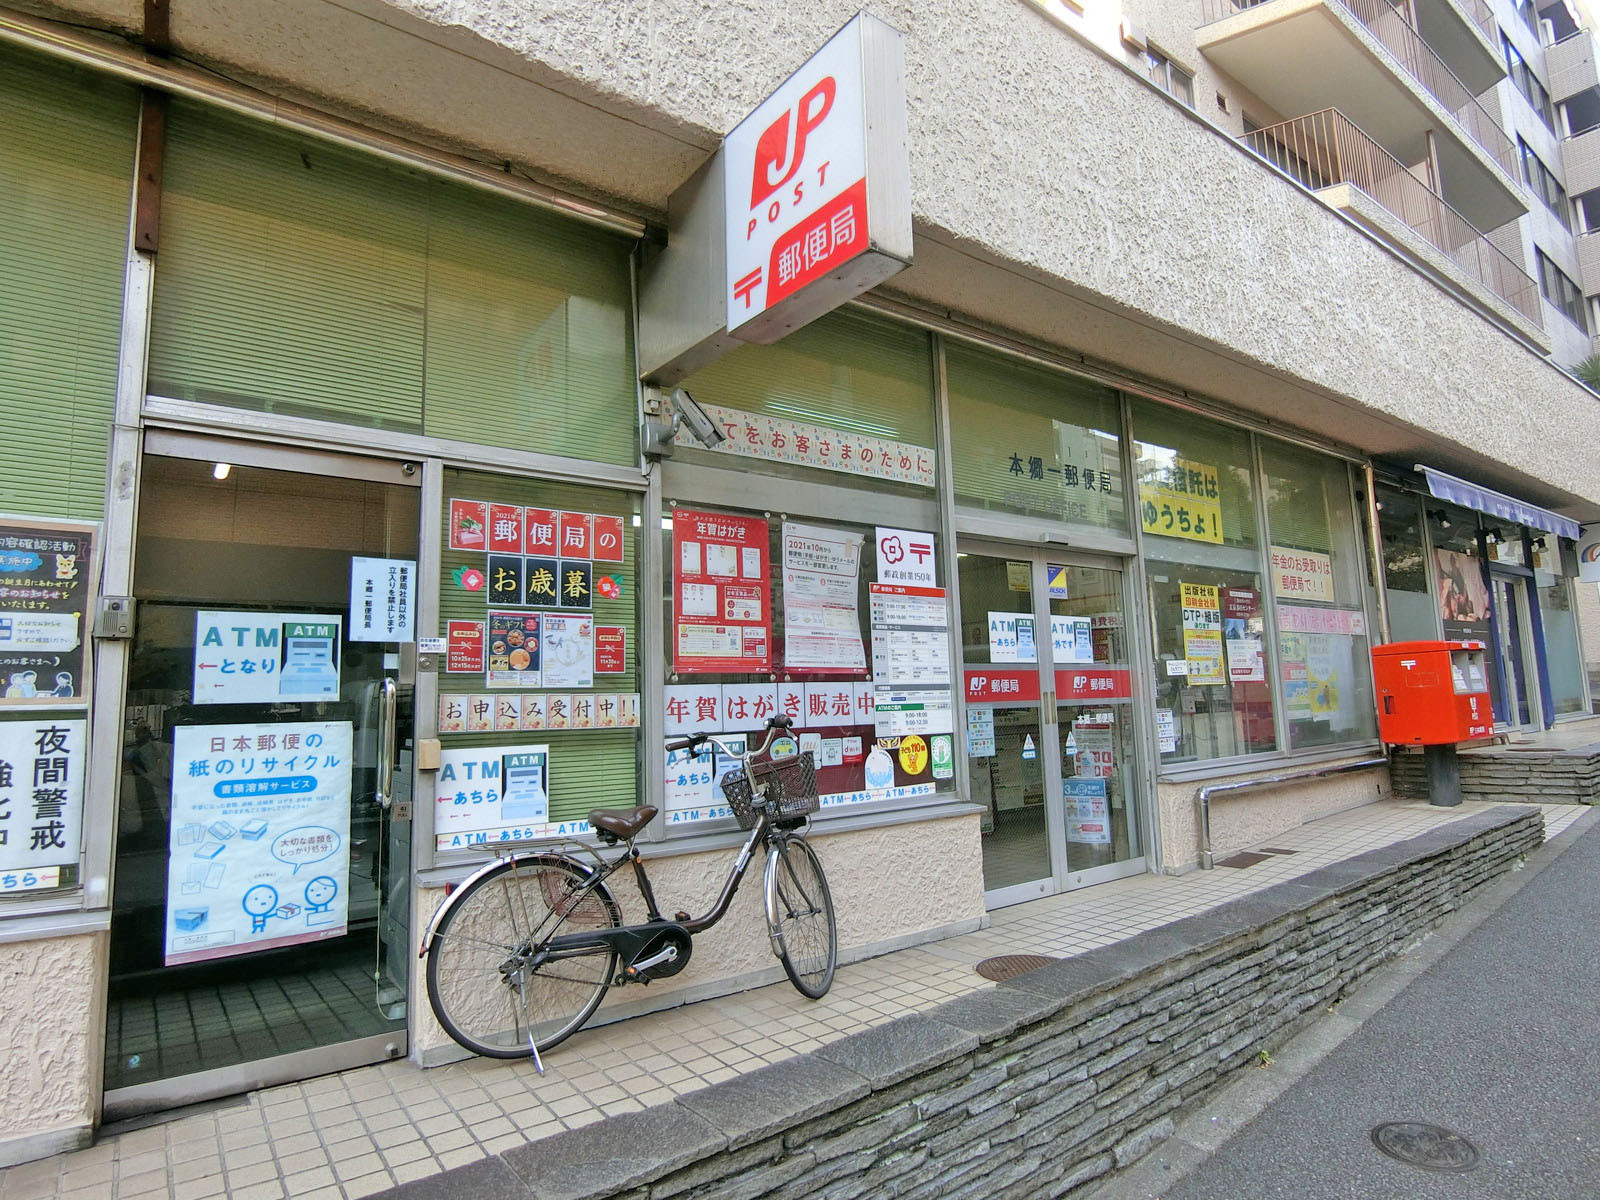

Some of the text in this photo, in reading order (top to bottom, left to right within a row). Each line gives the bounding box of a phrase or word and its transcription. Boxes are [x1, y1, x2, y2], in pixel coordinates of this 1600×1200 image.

[750, 76, 836, 211] JP
[747, 161, 830, 241] POST
[778, 204, 856, 287] 郵便局
[1009, 452, 1112, 495] 本郷一郵便局
[494, 519, 617, 550] 郵便局の
[697, 522, 746, 539] 年賀はがき
[1272, 553, 1330, 575] 年金のお受取りは
[494, 567, 589, 598] お歳暮
[884, 570, 931, 581] 郵政創業150年
[398, 567, 408, 628] 郵便局社員以外の
[1185, 586, 1214, 597] 出版社様
[364, 579, 373, 629] 本郷一郵便局長
[387, 567, 397, 634] 立入りを禁止します
[294, 626, 328, 636] ATM
[991, 620, 1015, 632] ATM
[1052, 623, 1073, 634] ATM
[203, 627, 278, 647] ATM
[997, 638, 1016, 647] あちら
[1055, 640, 1072, 649] 外です
[220, 659, 275, 674] となり
[970, 677, 987, 691] JP
[991, 679, 1019, 693] 郵便局
[1073, 676, 1087, 689] JP
[1090, 678, 1113, 690] 郵便局
[446, 699, 636, 721] お申込み受付中!!
[666, 692, 874, 723] 年賀はがき販売中
[210, 733, 323, 752] 日本郵便の
[188, 755, 340, 777] 紙のリサイクル
[511, 755, 539, 766] ATM
[440, 760, 499, 782] ATM
[677, 772, 710, 786] あちら
[30, 726, 71, 850] 夜間警戒
[221, 780, 310, 795] 書類溶解サービス
[886, 785, 929, 798] ATM あちら
[454, 789, 498, 805] あちら
[823, 792, 871, 805] ATM あちら
[673, 808, 734, 822] ATM あちら
[281, 835, 333, 847] 大切な書類を
[452, 822, 589, 846] ATM あちら ATM
[2, 872, 37, 889] ちら
